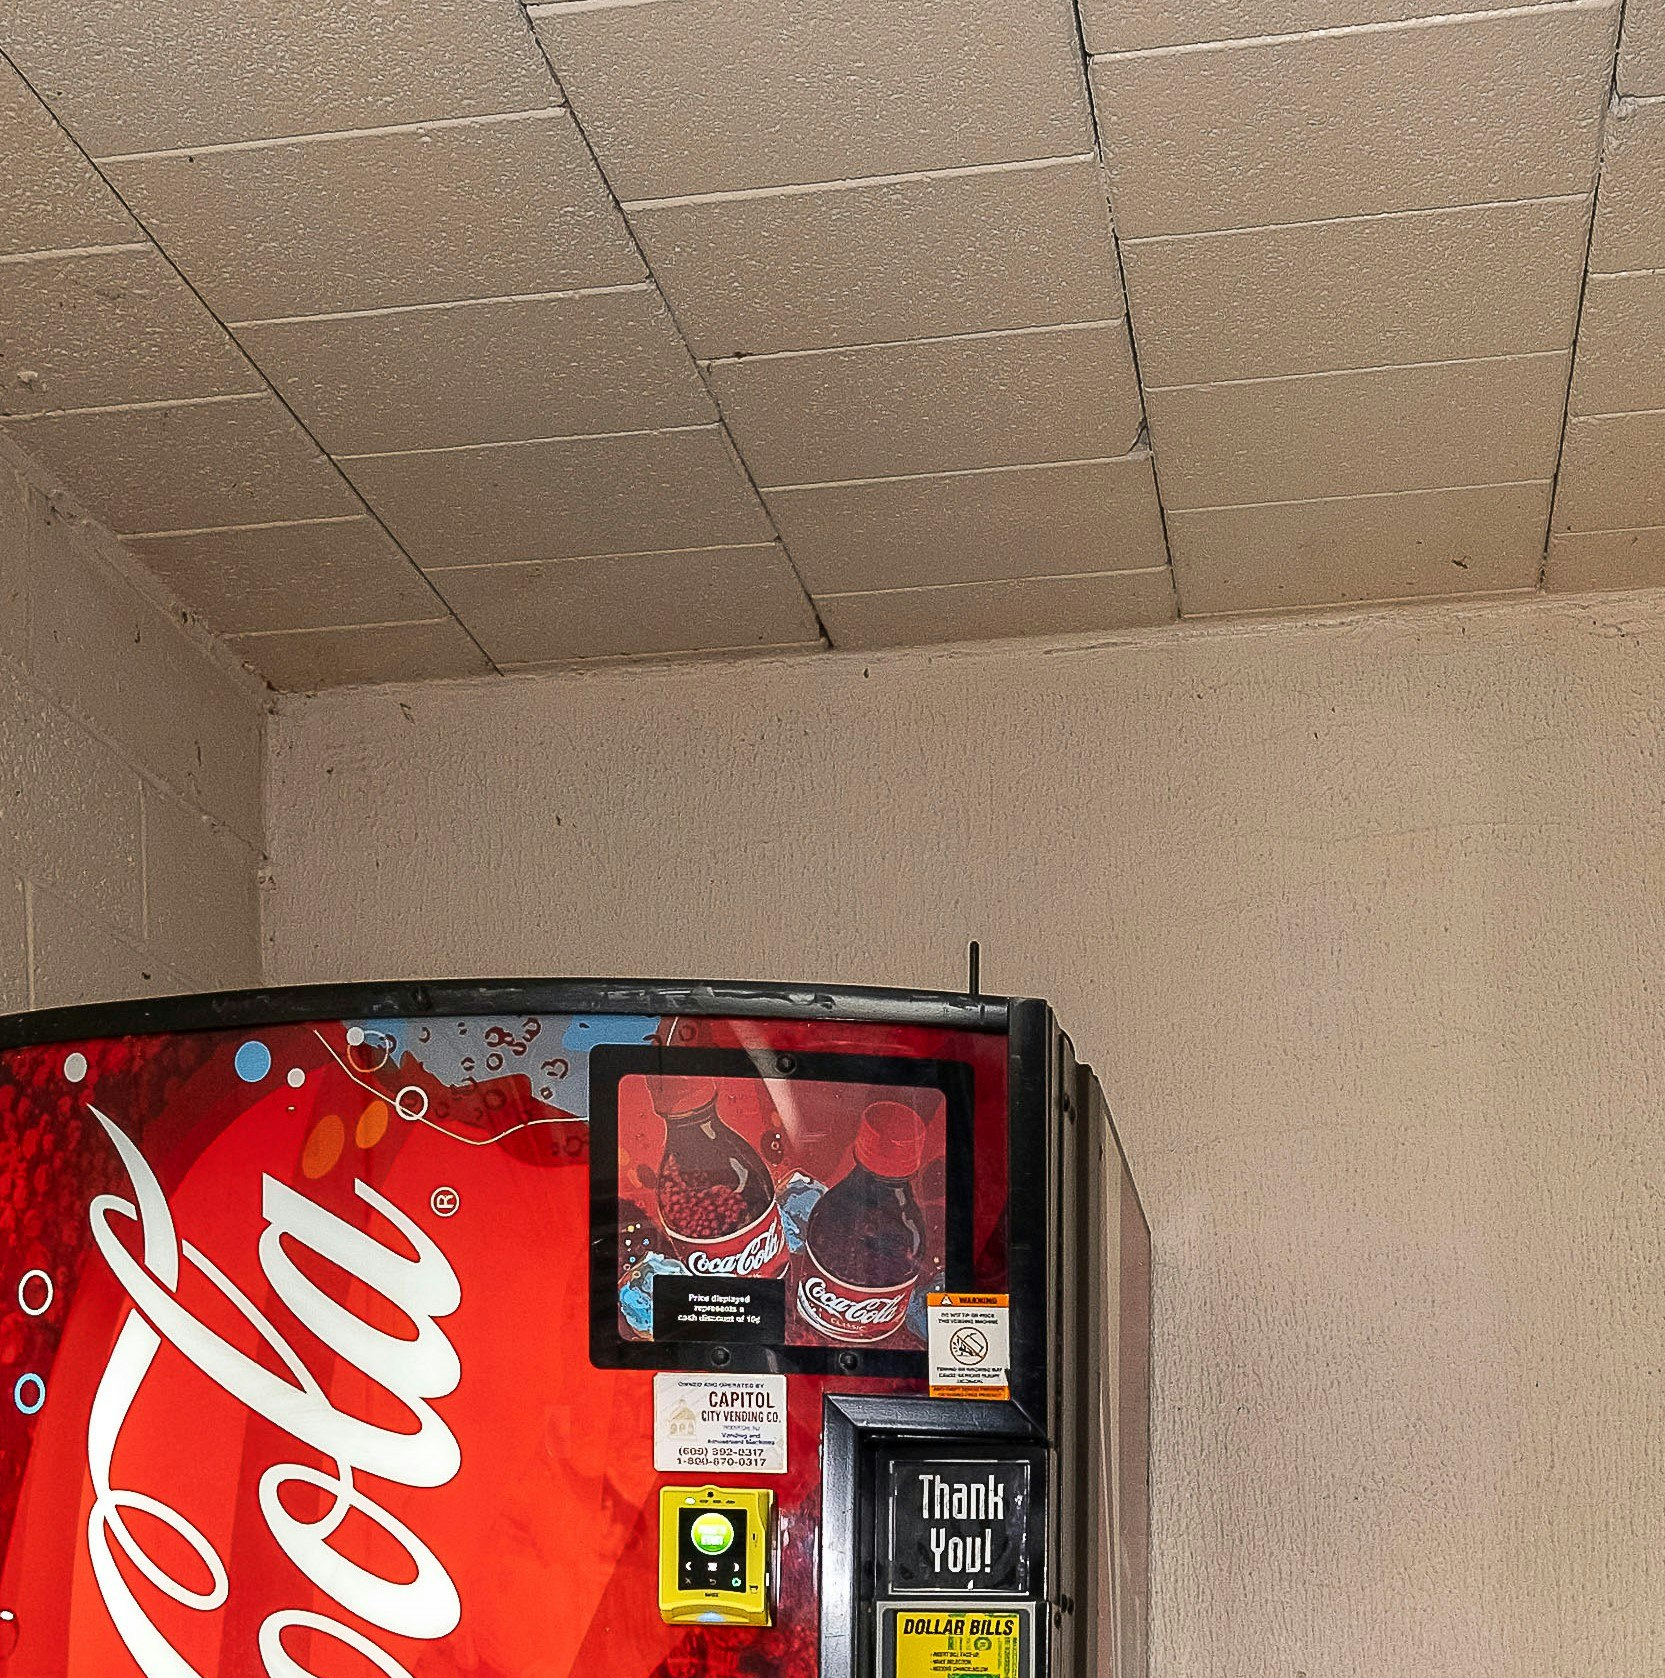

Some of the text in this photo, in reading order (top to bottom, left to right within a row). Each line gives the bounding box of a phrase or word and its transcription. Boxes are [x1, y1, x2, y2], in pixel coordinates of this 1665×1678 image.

[688, 1293, 751, 1305] Price displayed
[694, 1305, 737, 1313] represents
[677, 1313, 698, 1322] cash
[699, 1314, 735, 1323] discount
[736, 1314, 745, 1323] of
[708, 1391, 776, 1409] CAPITOL
[701, 1410, 782, 1424] CITY VENDING CO.
[678, 1447, 709, 1458] (609)
[918, 1474, 1005, 1520] Thank
[930, 1527, 992, 1574] You!
[903, 1618, 1016, 1637] DOLLAR BILLS
